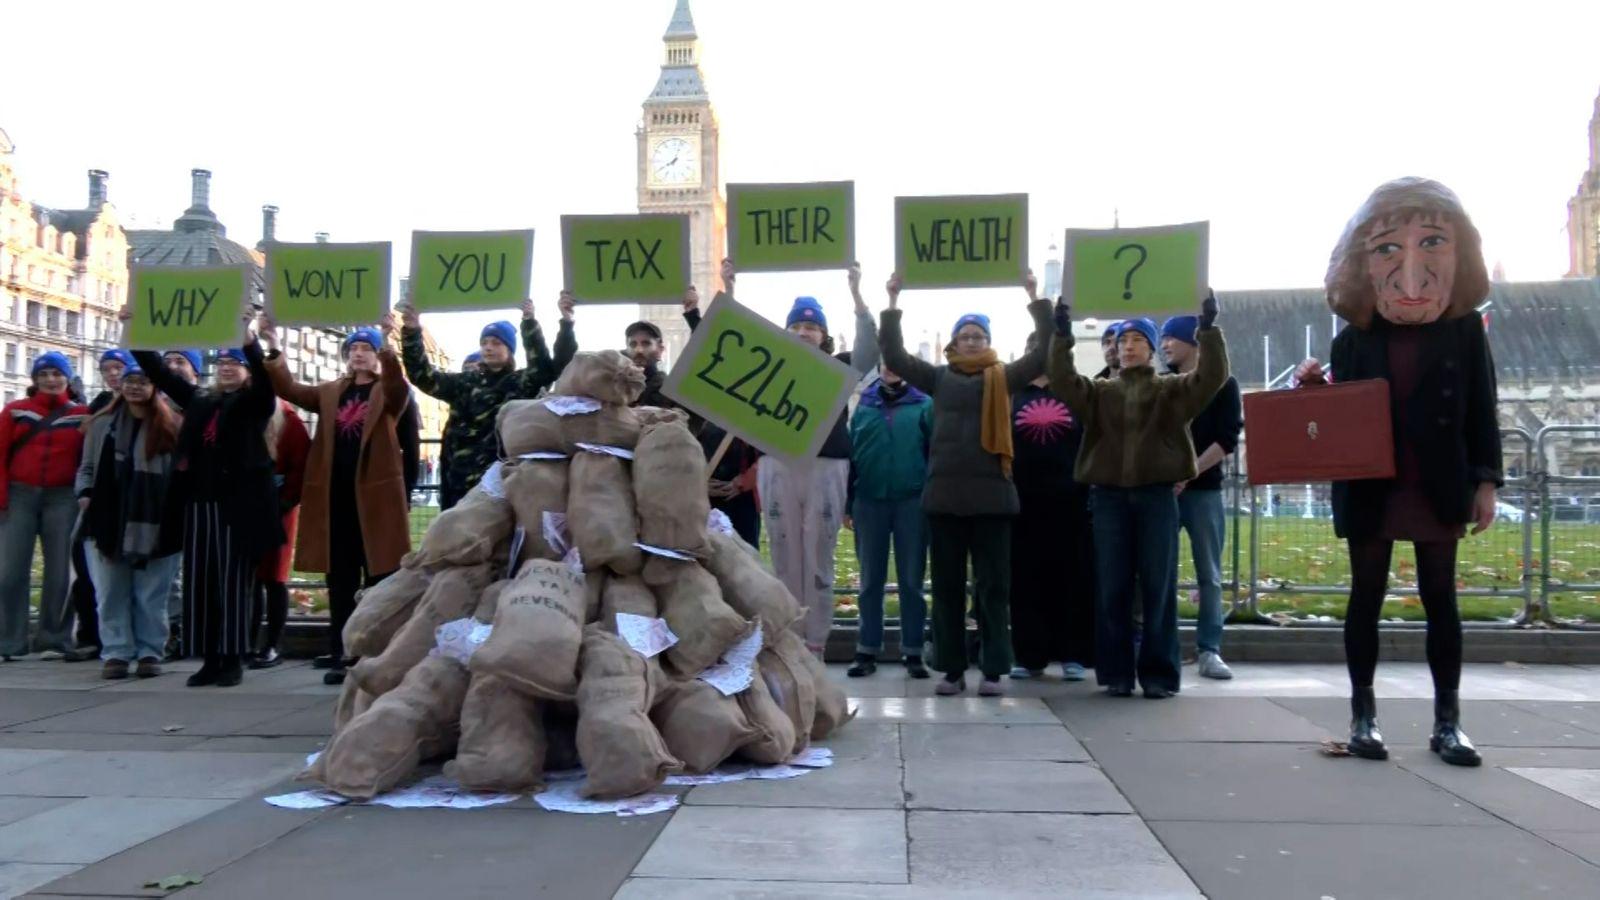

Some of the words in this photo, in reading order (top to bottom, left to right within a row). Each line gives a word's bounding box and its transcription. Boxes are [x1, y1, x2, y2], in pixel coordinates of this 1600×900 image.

[747, 206, 836, 245] THEIR
[911, 217, 1012, 262] WEALTH
[438, 253, 505, 292] YOU
[585, 239, 665, 282] TAX
[1114, 244, 1146, 300] ?
[284, 268, 368, 299] WONT
[149, 288, 219, 327] WHY
[696, 329, 808, 431] £24bn
